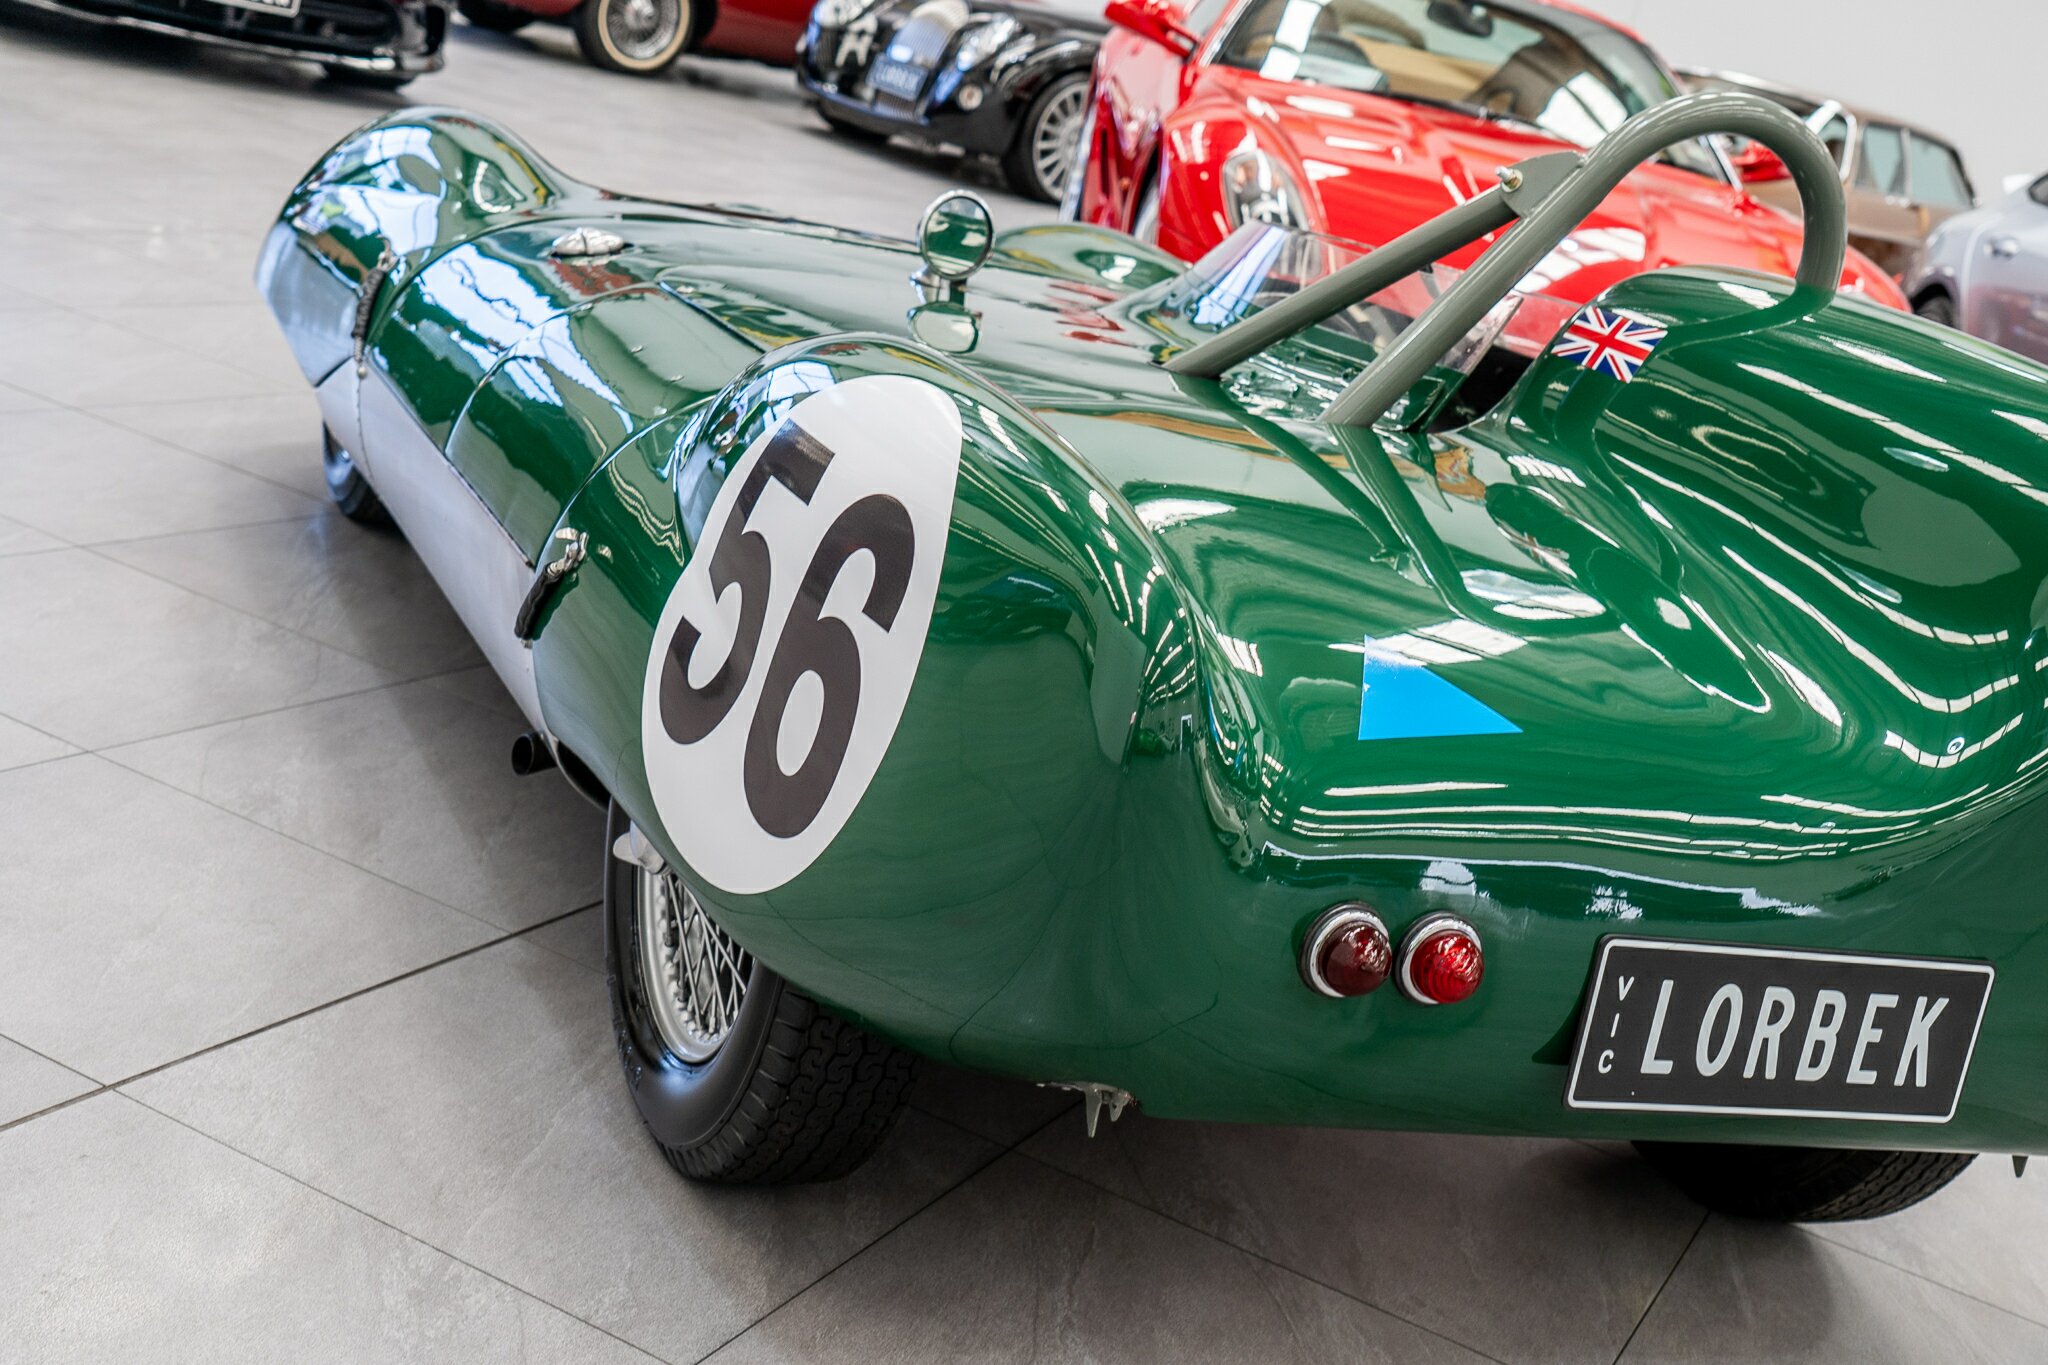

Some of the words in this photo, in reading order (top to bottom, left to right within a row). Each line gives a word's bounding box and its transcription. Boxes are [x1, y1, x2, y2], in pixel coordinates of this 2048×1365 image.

[659, 417, 916, 839] 56
[1597, 974, 1636, 1075] VIC
[1639, 978, 1951, 1088] LORBEK
